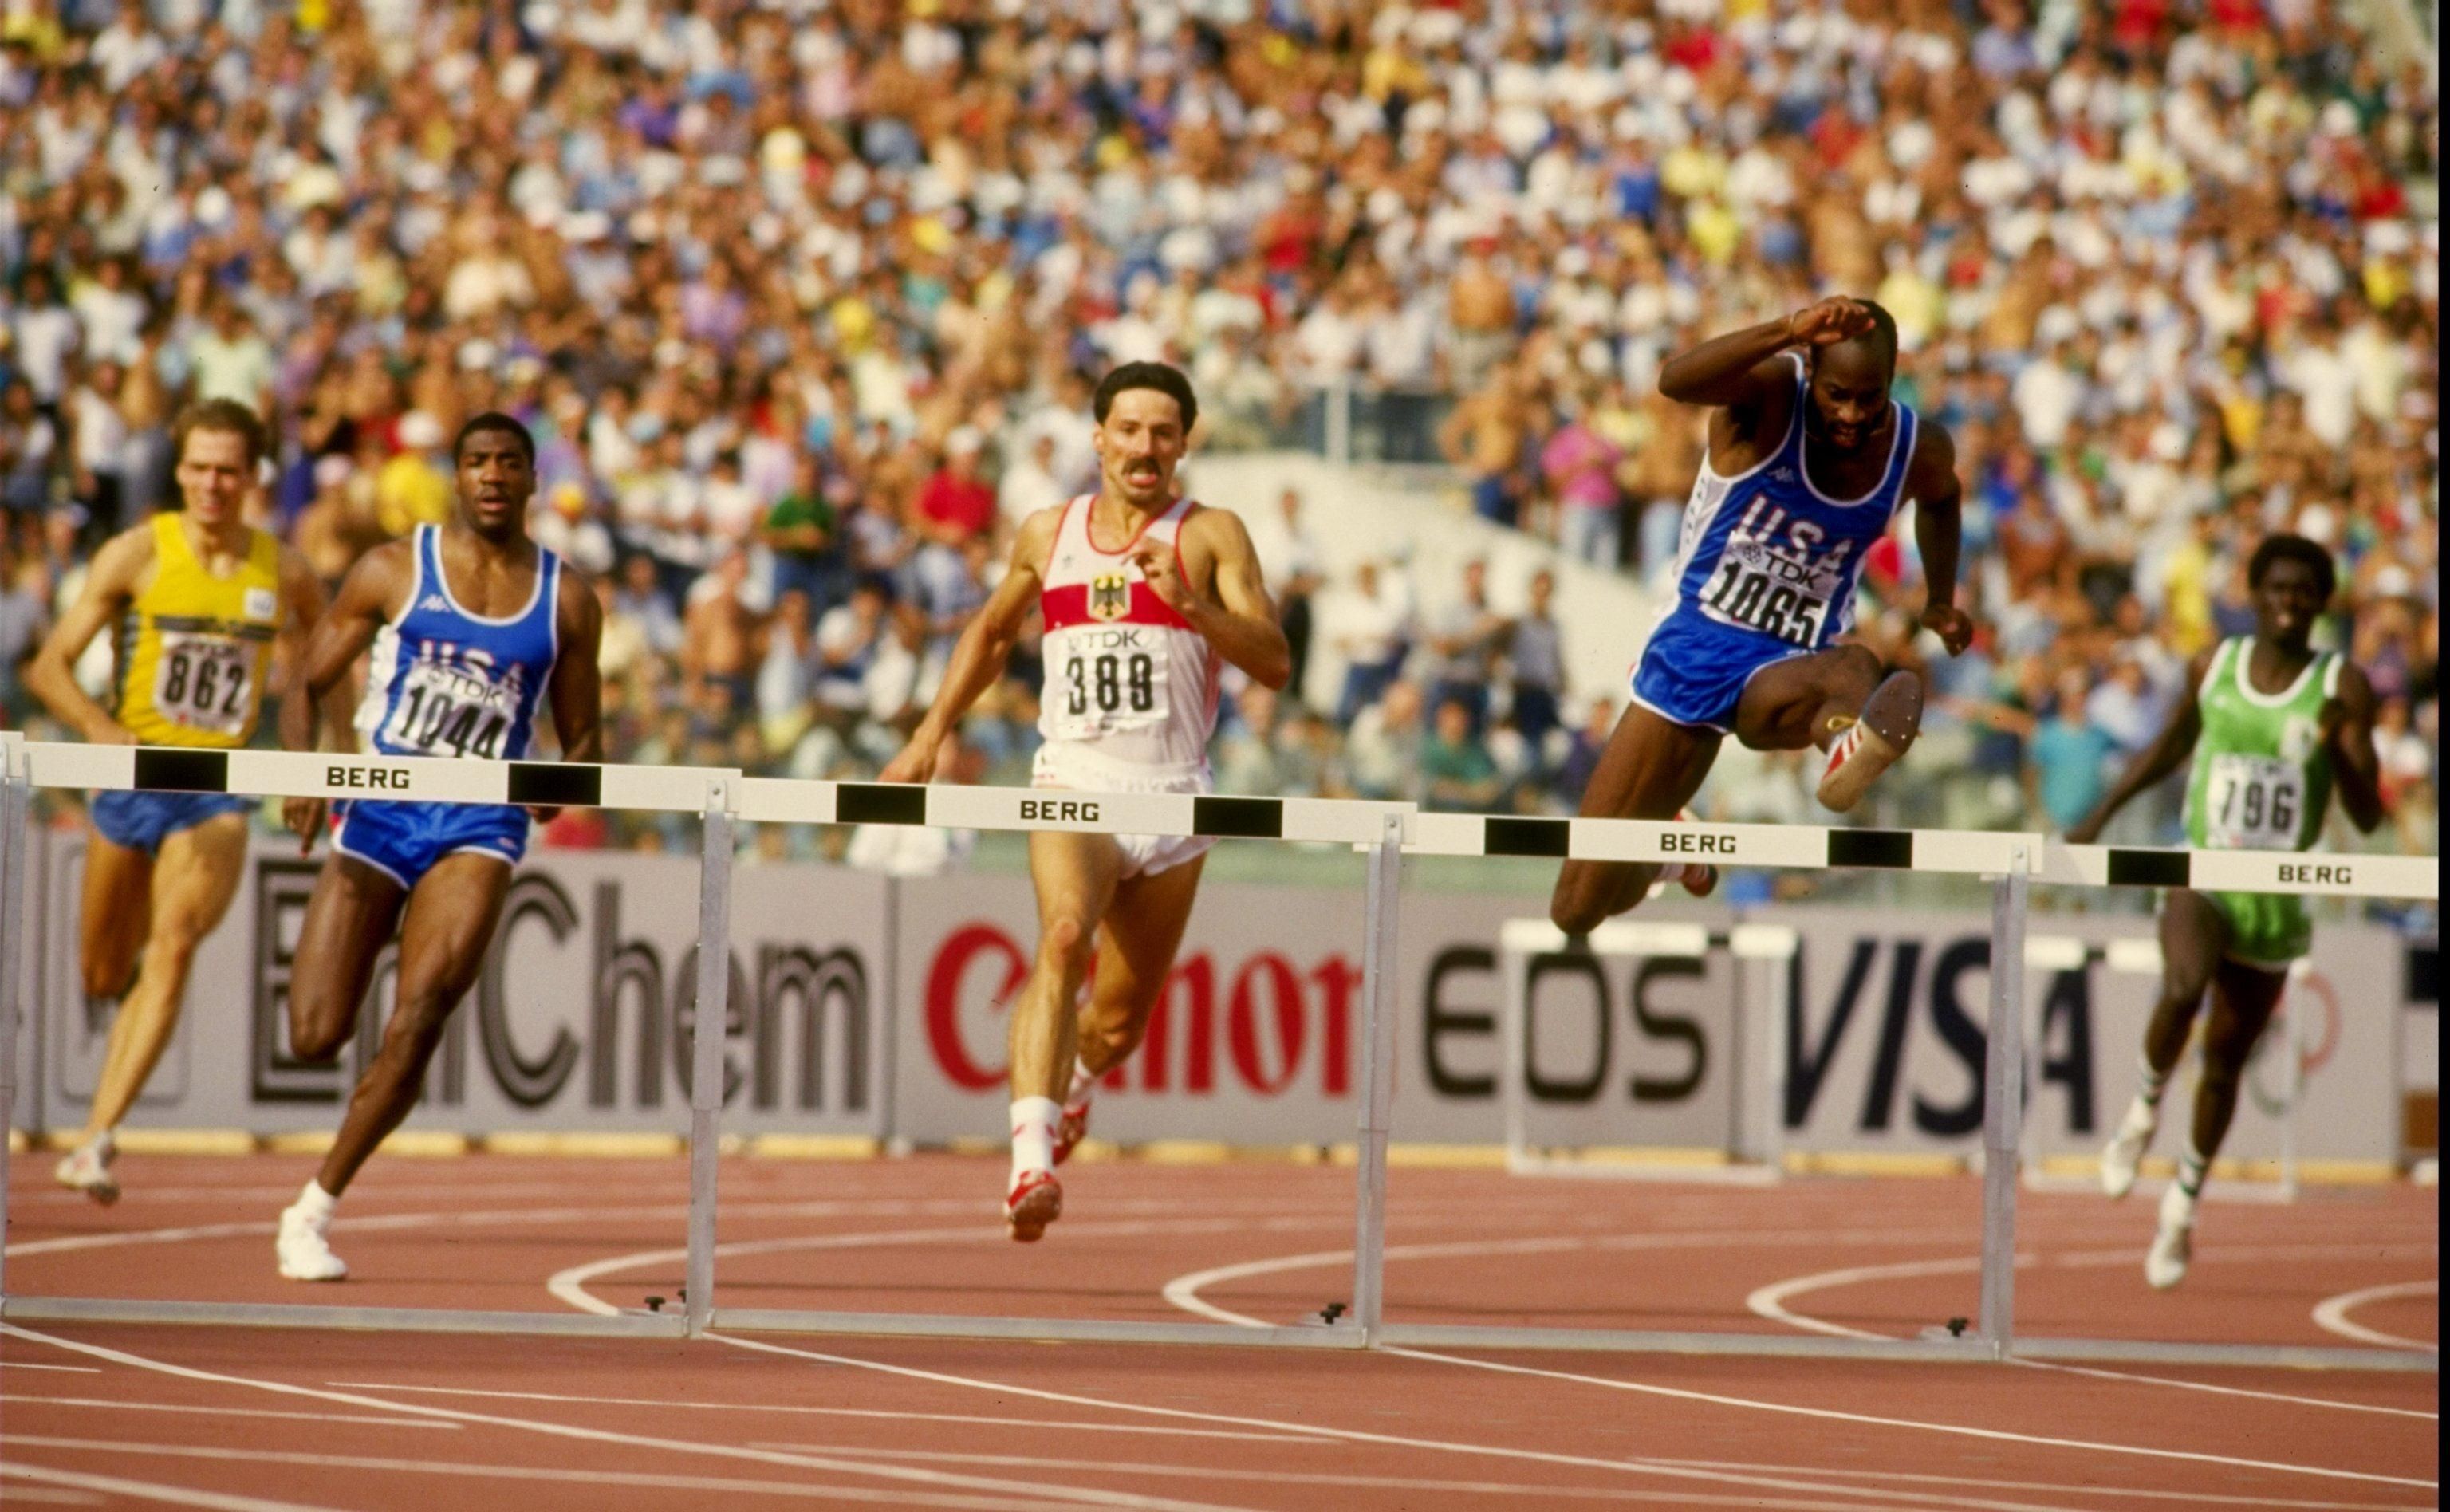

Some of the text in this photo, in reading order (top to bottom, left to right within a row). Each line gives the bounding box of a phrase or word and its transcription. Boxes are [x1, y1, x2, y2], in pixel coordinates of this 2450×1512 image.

[1764, 550, 1822, 590] TDK
[1711, 561, 1823, 648] 1065
[1083, 628, 1141, 648] TDK
[164, 652, 245, 716] 862
[448, 670, 504, 704] TDK
[1066, 653, 1154, 715] 389
[399, 683, 507, 759] 1044
[325, 766, 410, 789] BERG
[1019, 799, 1099, 822] BERG
[1660, 832, 1736, 854] BERG
[2278, 864, 2352, 884] BERG
[924, 920, 1708, 1101] Cno EOS
[1783, 934, 2096, 1136] VISA
